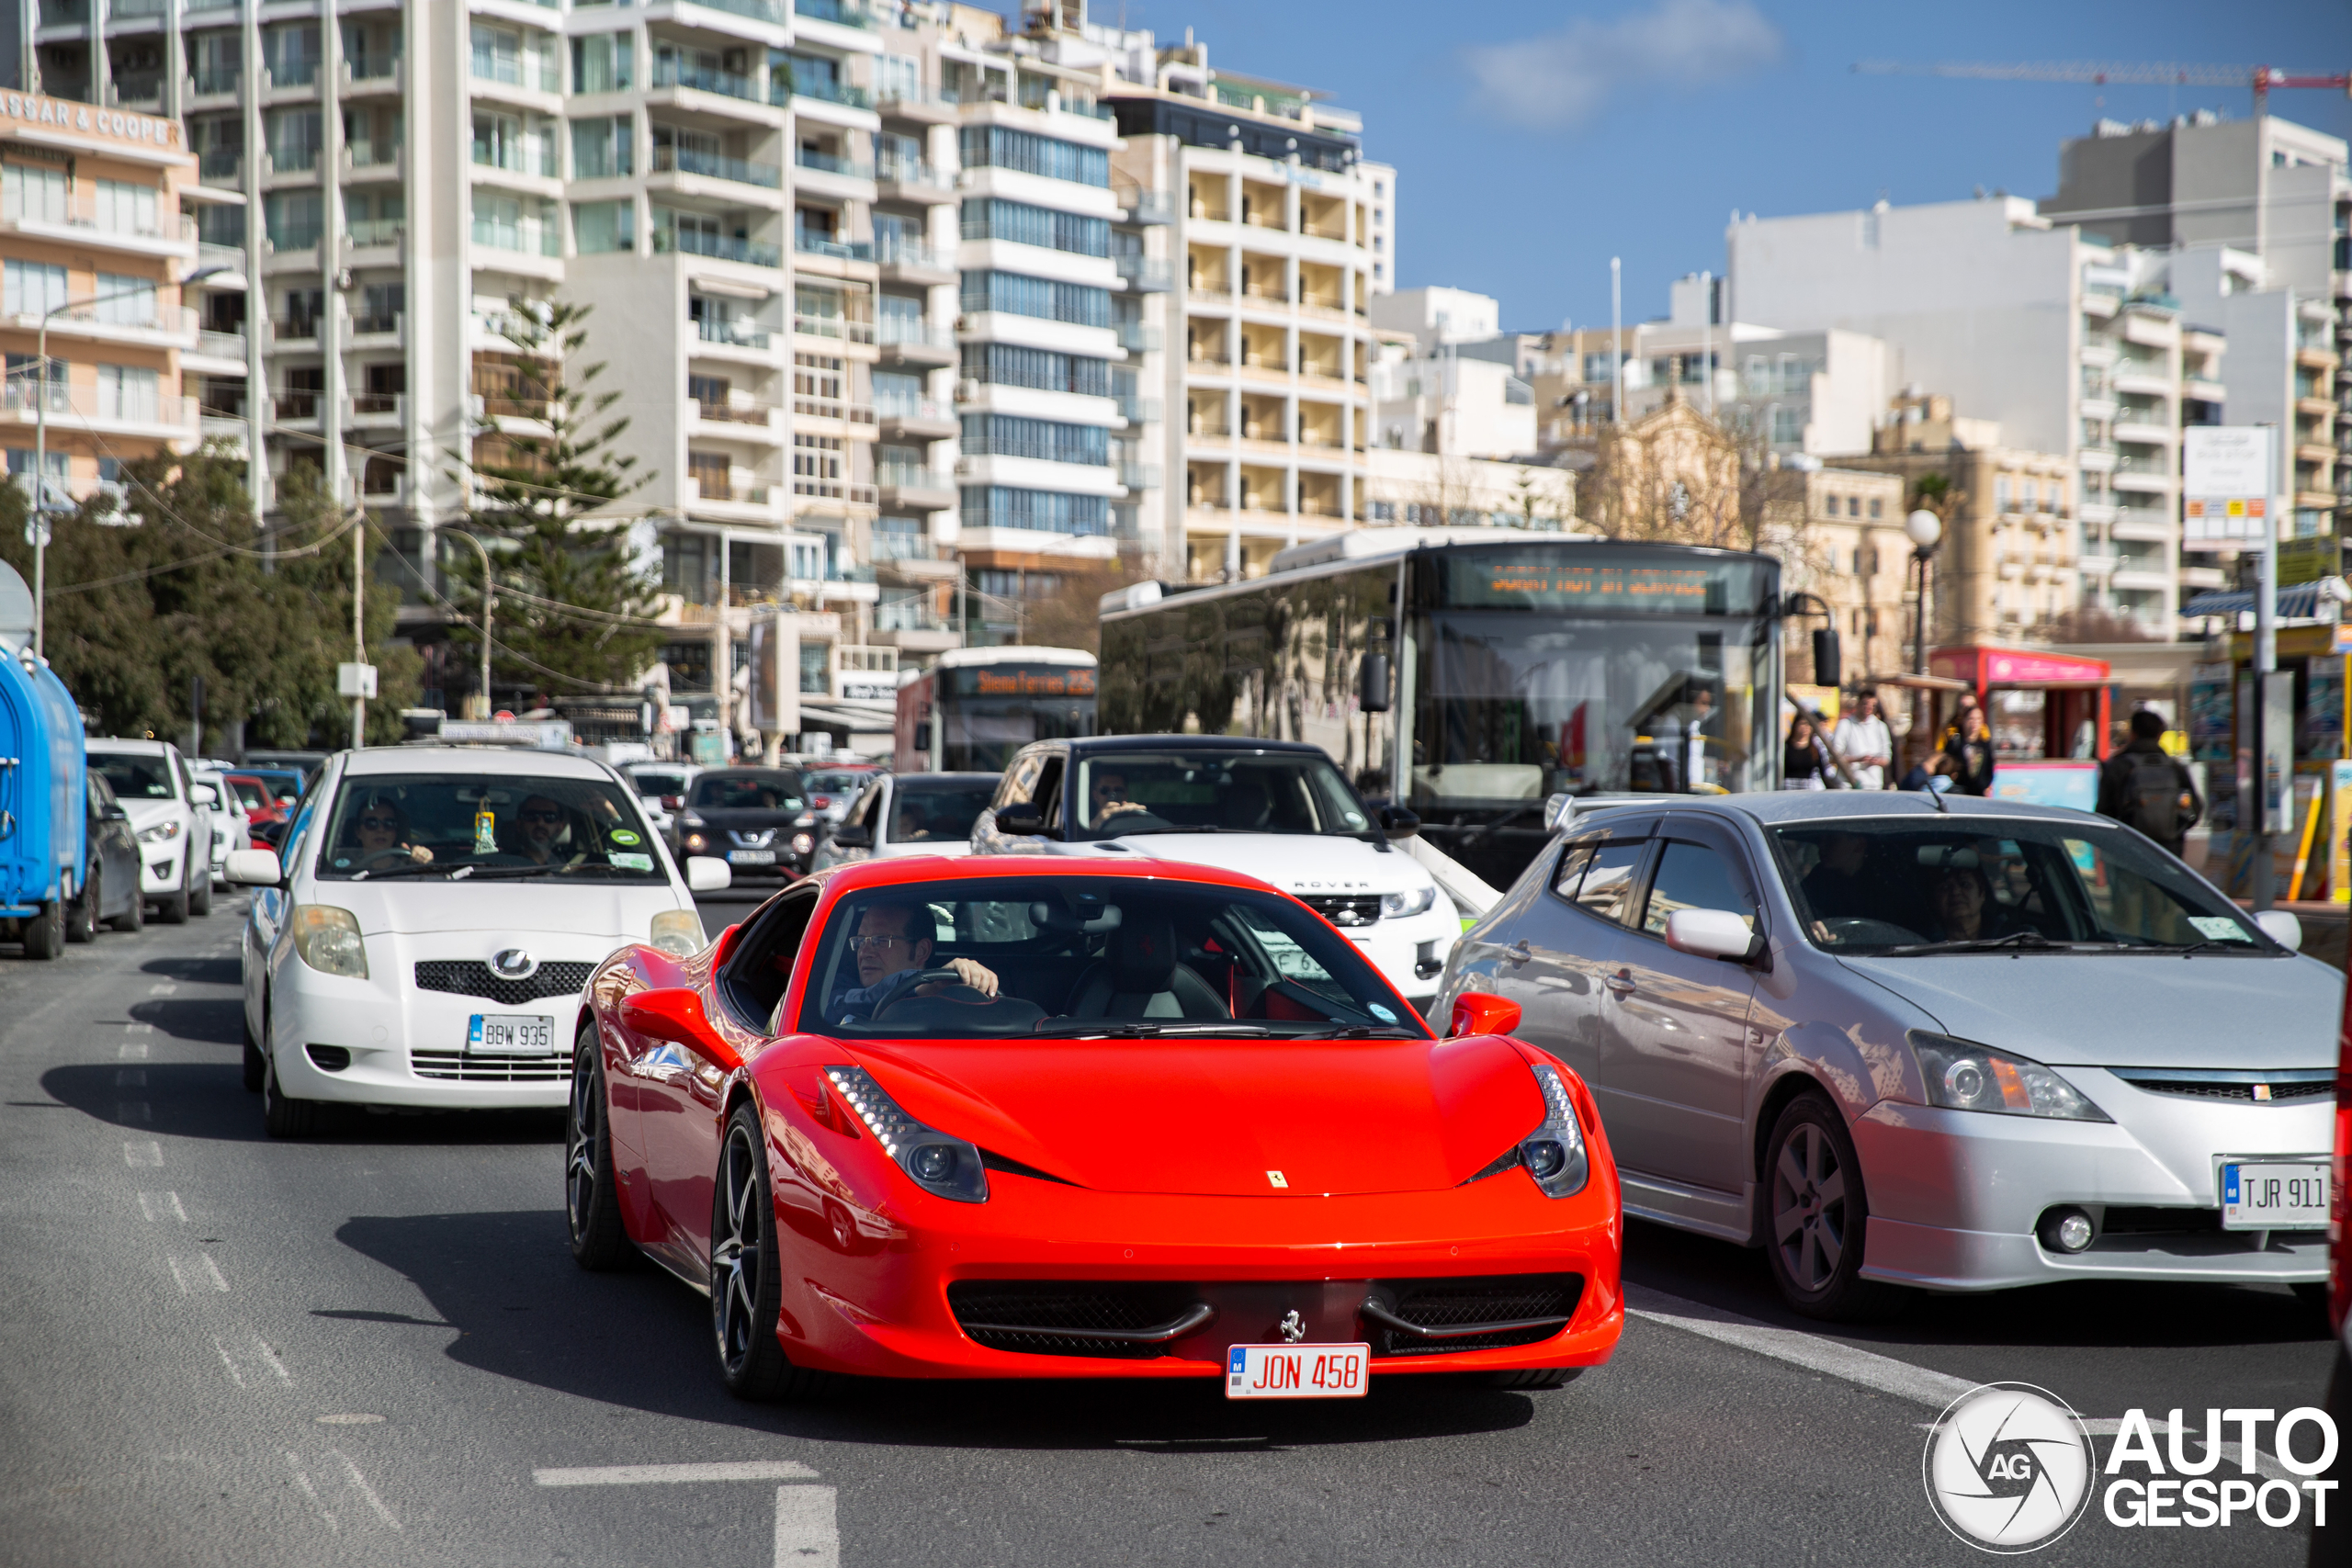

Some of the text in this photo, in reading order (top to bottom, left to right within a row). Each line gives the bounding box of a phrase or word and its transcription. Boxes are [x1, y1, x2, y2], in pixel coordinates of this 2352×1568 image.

[76, 106, 90, 131] &
[486, 1024, 548, 1045] BBW 935
[2244, 1178, 2325, 1208] TJR 911
[1233, 1362, 1242, 1371] M
[1253, 1354, 1360, 1389] JON 458
